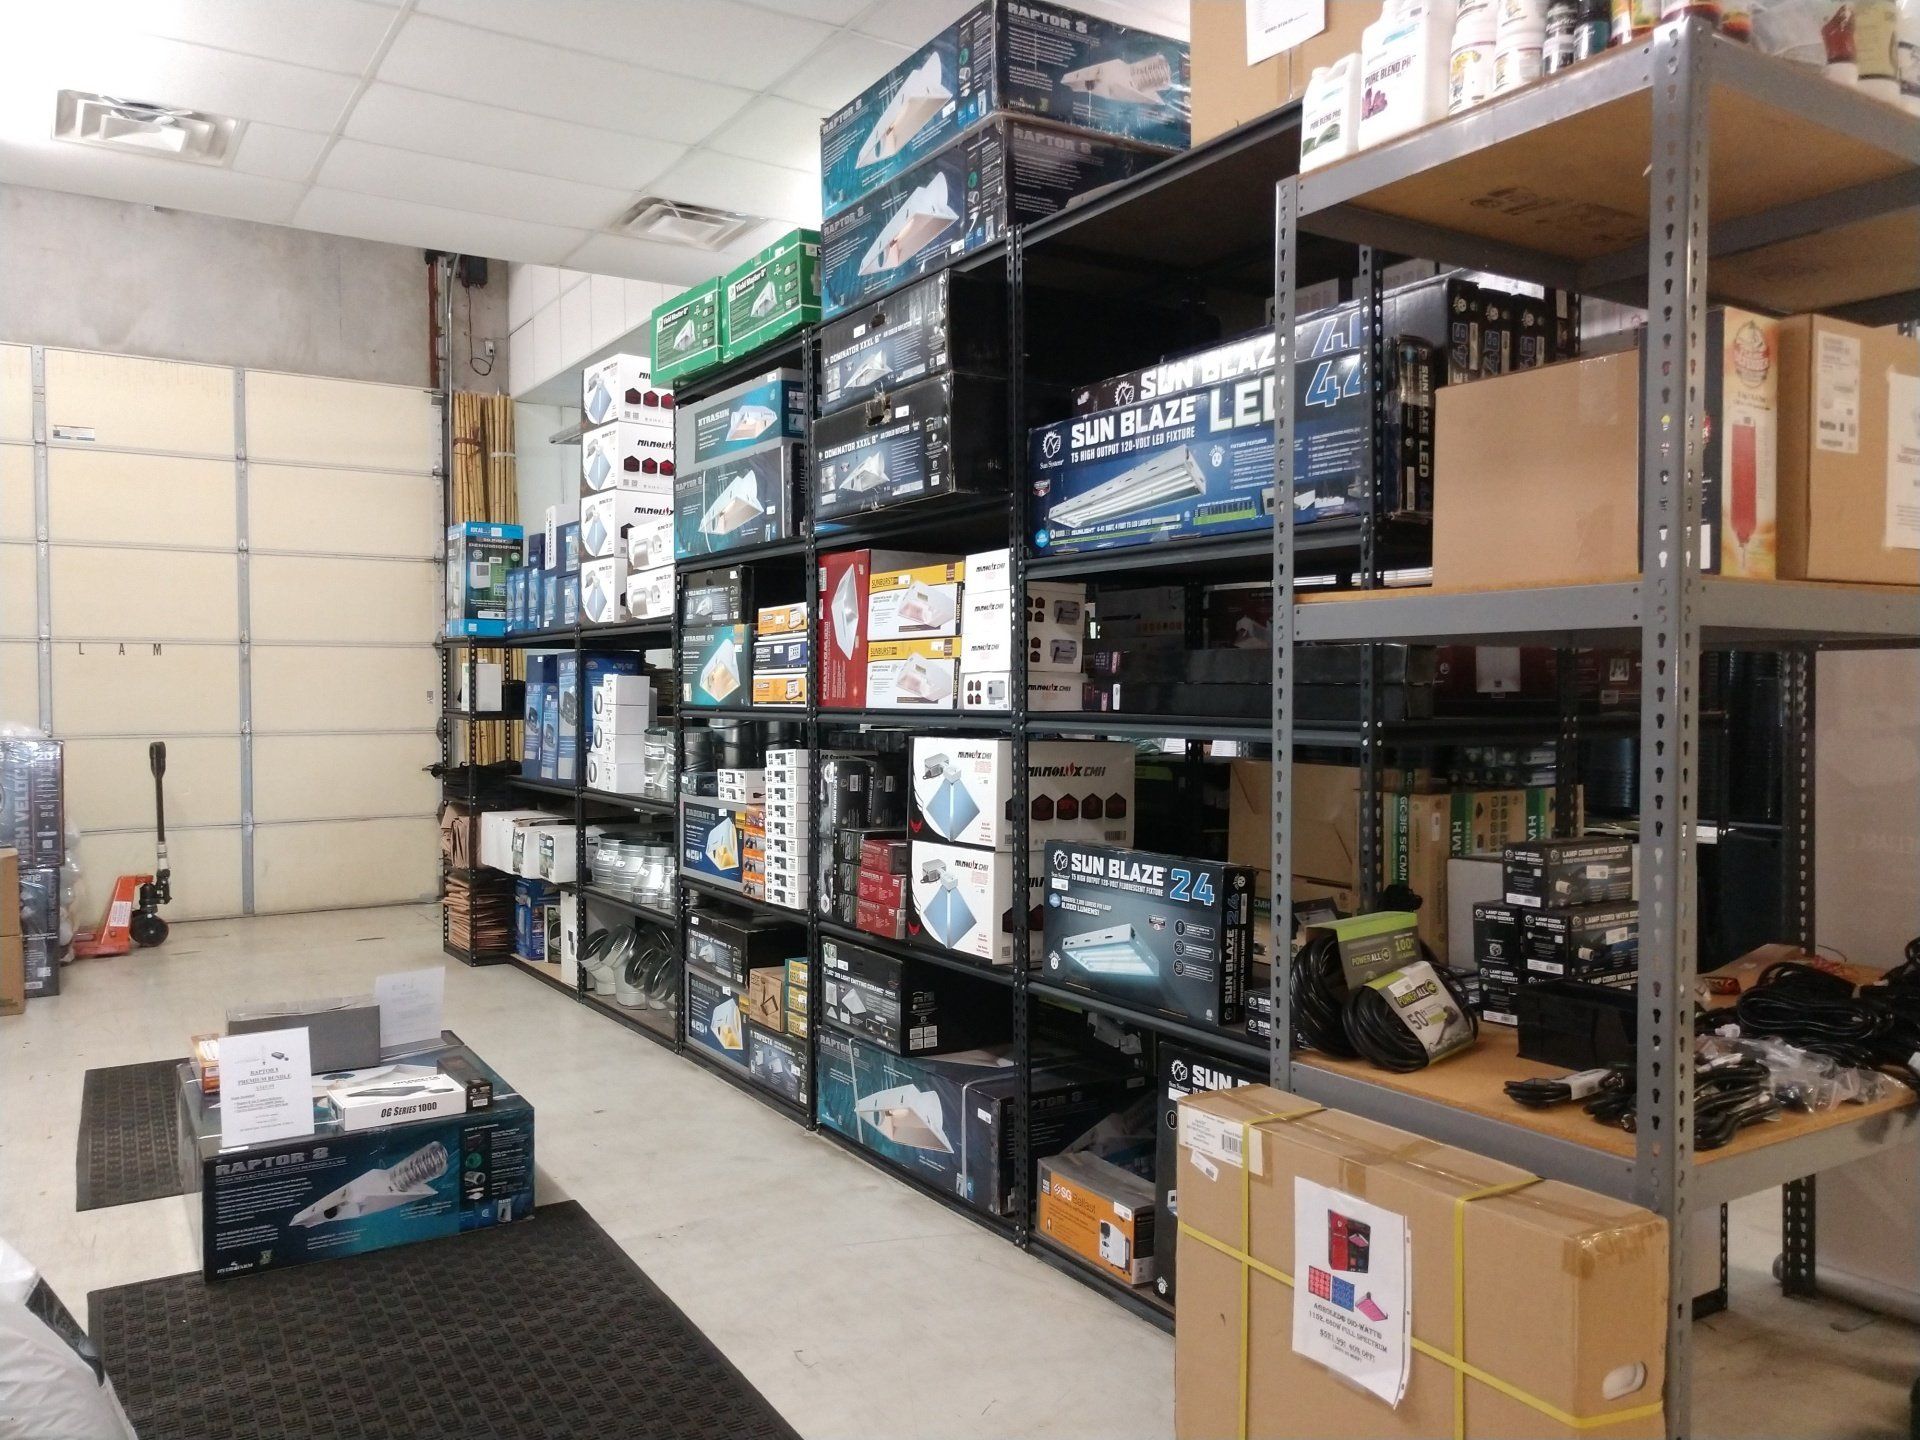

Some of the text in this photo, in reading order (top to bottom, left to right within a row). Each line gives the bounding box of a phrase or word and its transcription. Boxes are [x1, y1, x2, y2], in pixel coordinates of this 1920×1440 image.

[1007, 2, 1088, 34] RAPTOR 8
[1380, 61, 1401, 81] BLEND
[1013, 126, 1076, 152] RAPTOR
[823, 212, 855, 237] RAPTOR
[829, 344, 859, 364] DOMINATOR
[859, 338, 874, 351] XXXL
[1140, 332, 1275, 400] SUN BLAZ
[1421, 365, 1429, 392] SUN
[698, 408, 730, 427] XTRASUN
[1071, 414, 1115, 449] SUN
[1120, 395, 1197, 438] BLAZE
[824, 442, 856, 459] DOMINATOR
[856, 437, 871, 451] XXXL
[1070, 426, 1195, 464] T5 HIGH OUTPUT 120-VOLT LED FIXTURE
[1419, 440, 1429, 478] LED
[78, 642, 162, 656] L A M
[1083, 766, 1107, 777] CMH
[1562, 850, 1578, 858] LAMP
[1071, 853, 1215, 907] SUN BLAZE 24
[1399, 854, 1408, 881] CMH
[1076, 874, 1087, 883] HIGH
[1086, 875, 1101, 885] OUTPUT
[1145, 885, 1164, 897] FIXTURE
[1584, 915, 1600, 924] LAMP
[1600, 914, 1615, 922] CORD
[1616, 912, 1629, 920] WITH
[1225, 928, 1235, 973] BLAZE
[1224, 975, 1233, 1004] SUN
[1407, 1010, 1429, 1030] 50
[1192, 1064, 1232, 1091] SUN
[380, 1107, 392, 1118] OG
[418, 1101, 438, 1113] 1000
[215, 1152, 306, 1177] RAPTOR
[312, 1147, 329, 1160] 8
[1356, 1333, 1388, 1353] SPECTRUM
